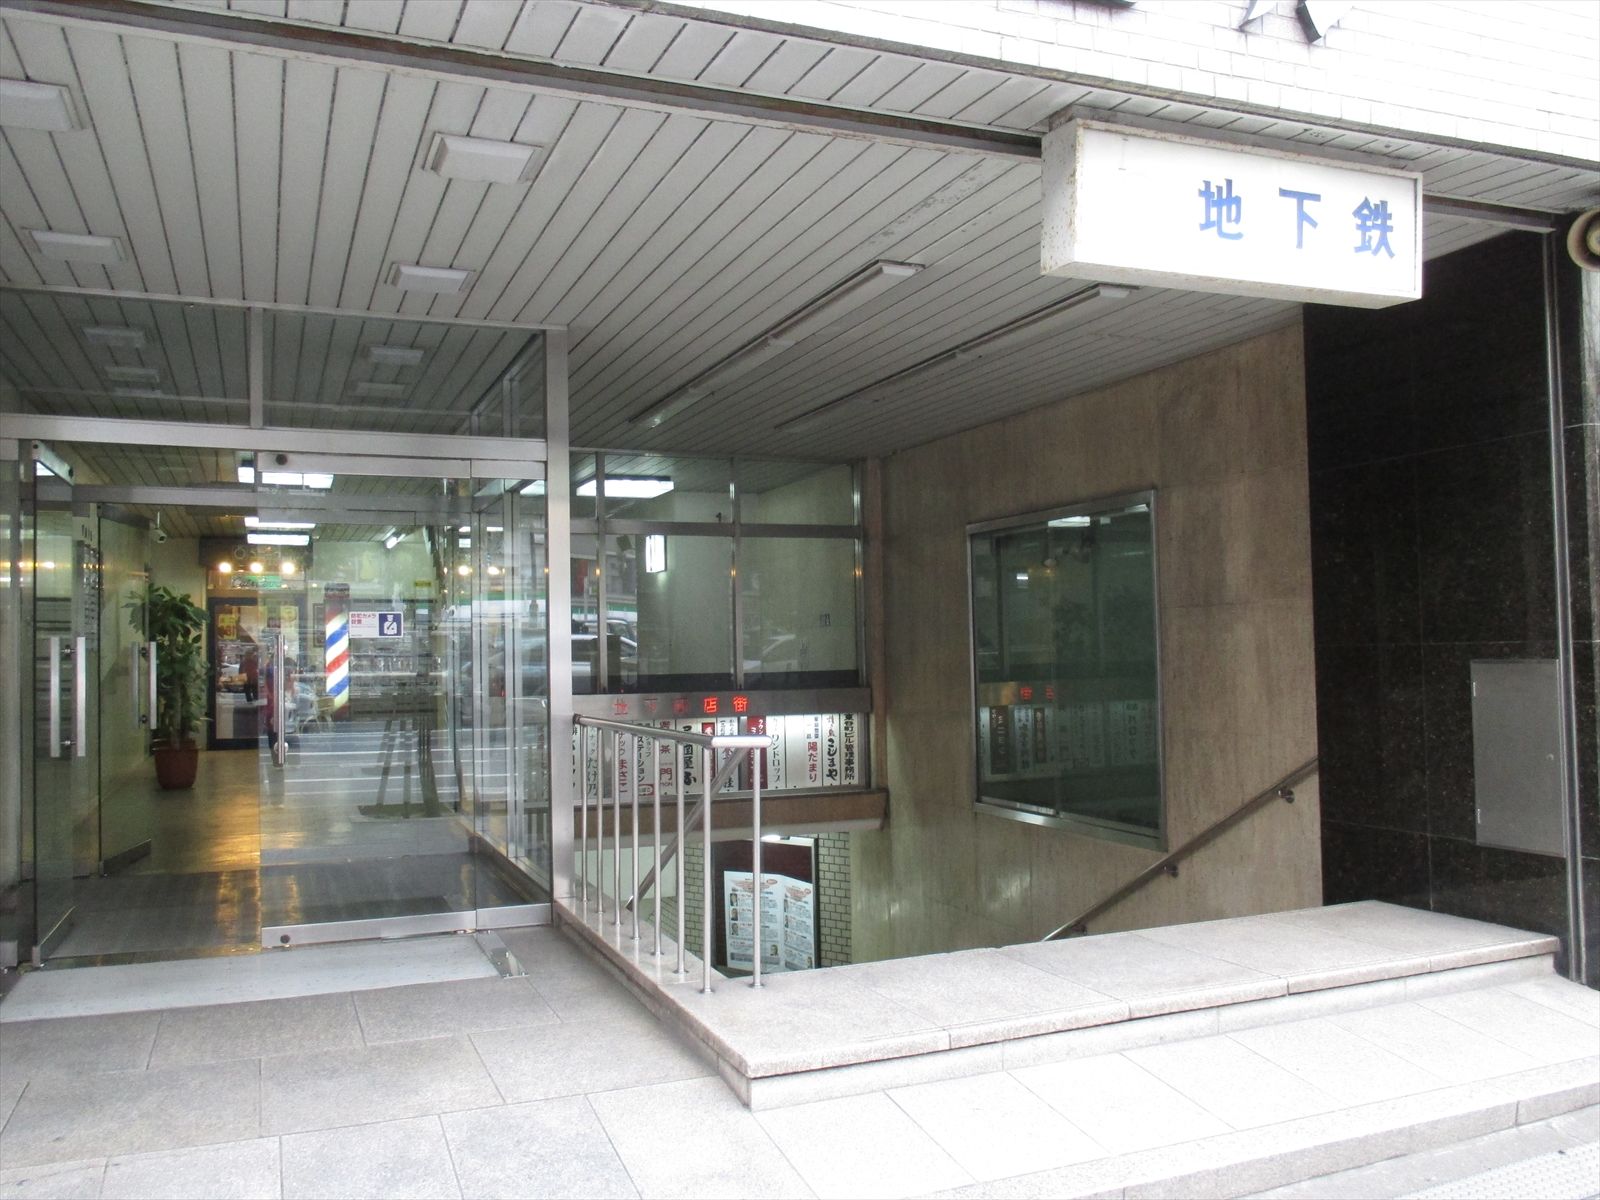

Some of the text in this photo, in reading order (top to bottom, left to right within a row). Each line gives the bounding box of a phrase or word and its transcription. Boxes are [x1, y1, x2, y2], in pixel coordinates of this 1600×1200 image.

[1197, 178, 1396, 258] 地下鉄
[807, 741, 819, 783] 陽だまり
[826, 737, 838, 781] こじまや
